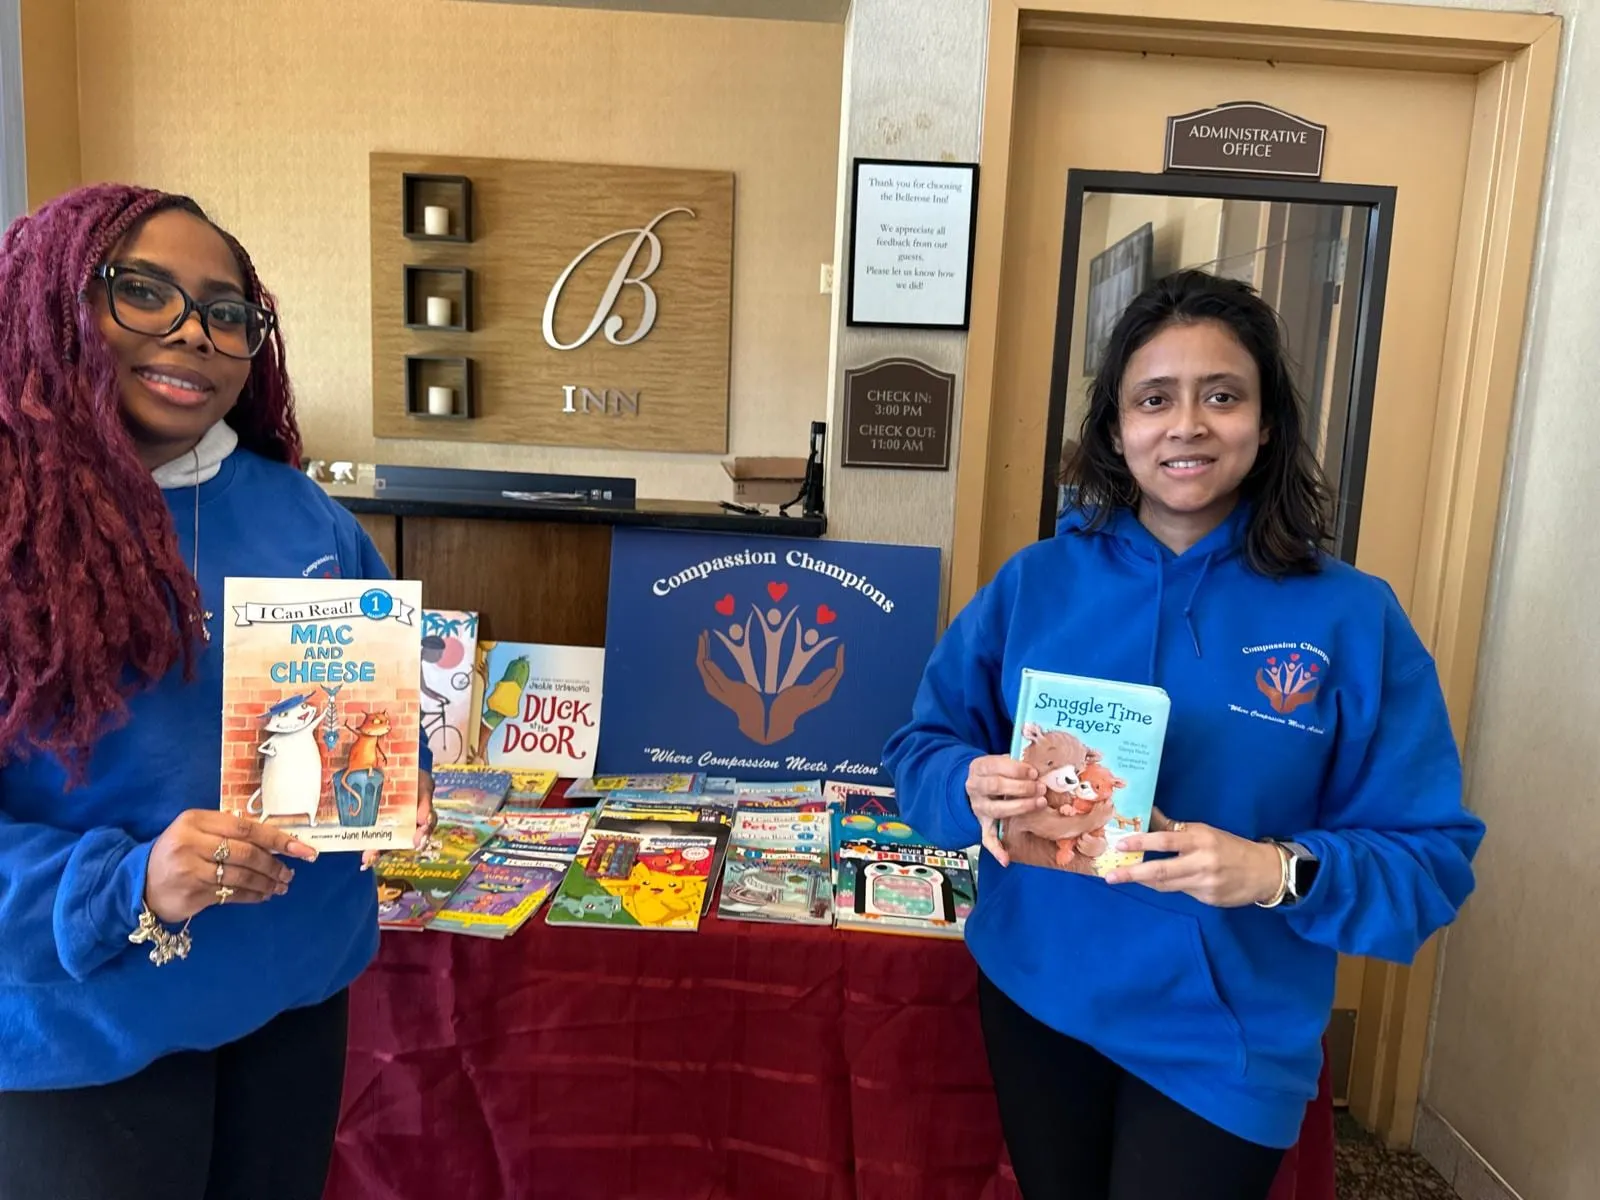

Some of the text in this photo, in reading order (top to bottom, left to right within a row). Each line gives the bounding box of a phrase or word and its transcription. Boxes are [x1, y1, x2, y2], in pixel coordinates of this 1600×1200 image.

[1188, 125, 1308, 144] ADMINISTRATIVE
[1222, 142, 1273, 158] OFFICE
[869, 177, 963, 193] Thank you for choosing
[880, 192, 893, 201] the
[880, 223, 946, 236] We appreciate all
[876, 237, 948, 249] feedback from our
[542, 207, 696, 351] B
[866, 265, 890, 275] Please
[892, 266, 901, 276] let
[914, 267, 936, 278] know
[938, 269, 955, 278] how
[896, 282, 907, 290] we
[562, 385, 643, 417] INN
[867, 390, 932, 404] CHECK IN:
[874, 404, 923, 417] 3:00 PM
[859, 424, 937, 439] CHECK OUT:
[871, 438, 924, 451] 11:00 AM
[652, 549, 895, 613] Compassion Champions
[260, 607, 267, 620] I
[271, 607, 304, 619] Can
[309, 602, 354, 617] Read!
[371, 596, 380, 612] 1
[290, 624, 354, 645] MAC
[304, 646, 344, 660] AND
[270, 661, 376, 684] CHEESE
[523, 693, 595, 728] DUCK
[1034, 693, 1153, 726] Snuggle Time
[1055, 711, 1122, 735] Prayers
[502, 723, 587, 760] DOOR
[698, 751, 780, 769] Compassion
[785, 756, 828, 774] Meets
[342, 831, 359, 840] Jane
[361, 830, 393, 841] Manning
[924, 848, 956, 858] POP
[382, 868, 461, 880] Backpack
